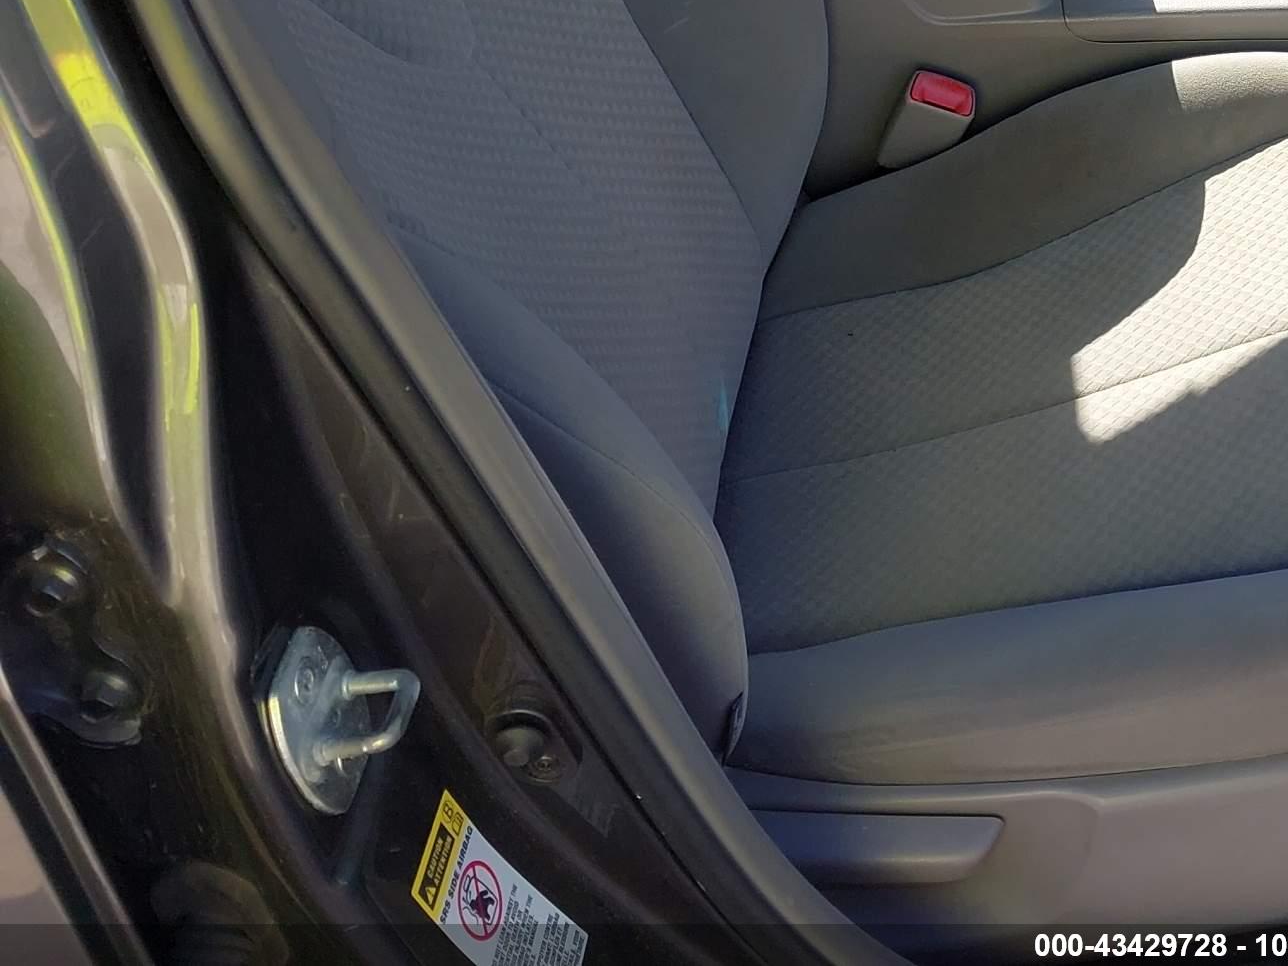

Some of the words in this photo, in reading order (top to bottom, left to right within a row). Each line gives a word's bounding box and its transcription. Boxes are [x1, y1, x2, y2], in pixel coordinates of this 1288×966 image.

[439, 899, 451, 925] SRS
[447, 869, 459, 899] SIDE
[456, 824, 473, 870] AIRBAG
